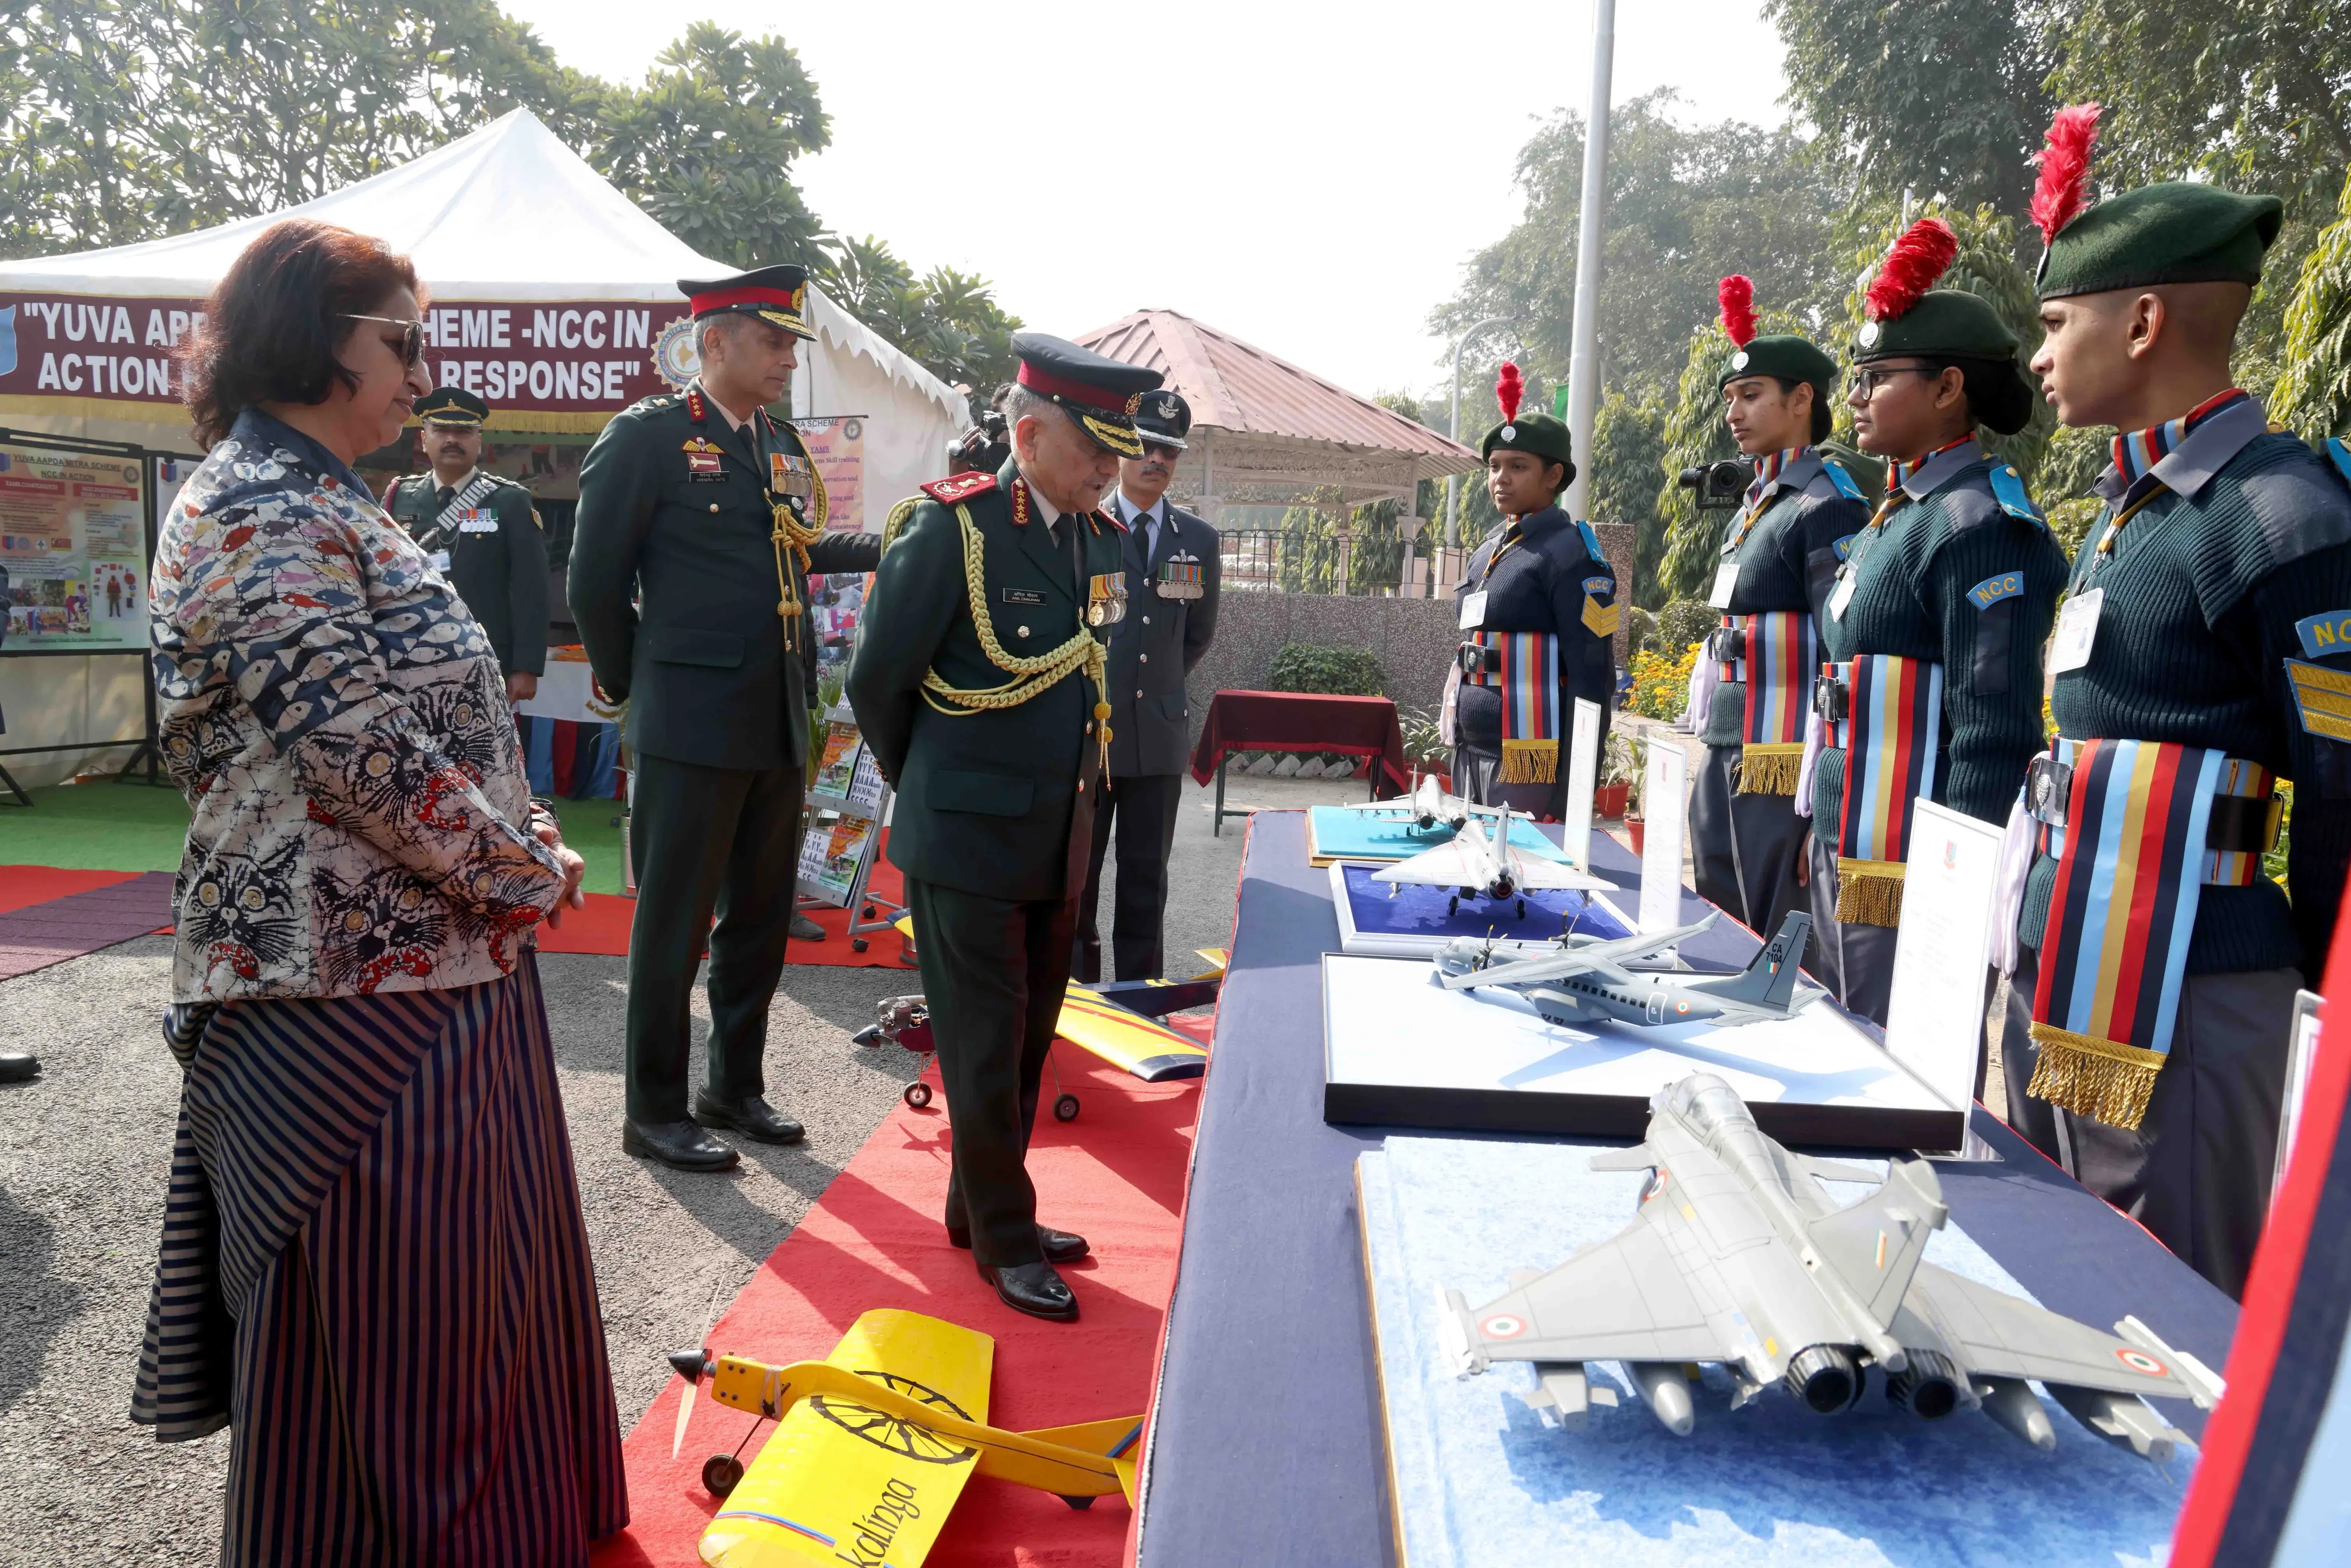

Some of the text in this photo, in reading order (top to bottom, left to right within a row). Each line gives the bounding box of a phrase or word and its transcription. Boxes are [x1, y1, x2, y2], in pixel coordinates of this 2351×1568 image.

[24, 302, 135, 344] "YUVA
[613, 310, 649, 348] IN
[660, 326, 682, 351] DISASTER
[38, 353, 169, 395] ACTION
[440, 361, 640, 399] RESPONSE"
[807, 419, 839, 427] SCHEME
[37, 457, 63, 466] AAPDA
[91, 462, 121, 471] SCHEME
[1588, 580, 1608, 591] NCC
[1977, 577, 2016, 604] NCC
[1772, 943, 1782, 953] CA
[1766, 952, 1782, 964] 7104
